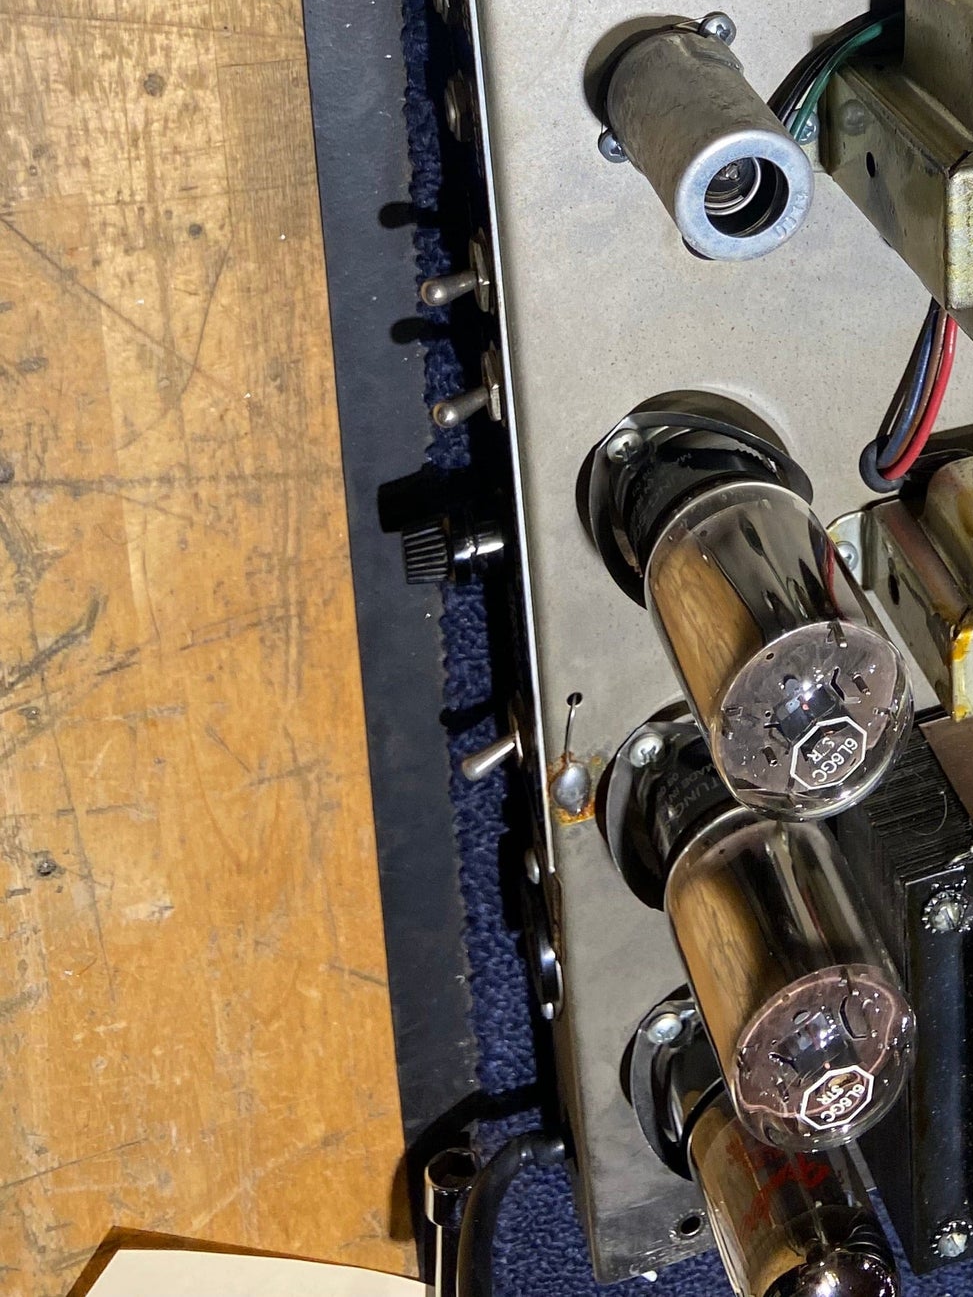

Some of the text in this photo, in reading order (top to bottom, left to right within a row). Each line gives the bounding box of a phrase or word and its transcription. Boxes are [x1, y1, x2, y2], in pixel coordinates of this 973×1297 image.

[811, 736, 859, 784] 6L6GC
[814, 1083, 845, 1106] STR
[819, 1083, 866, 1124] 6L6GC
